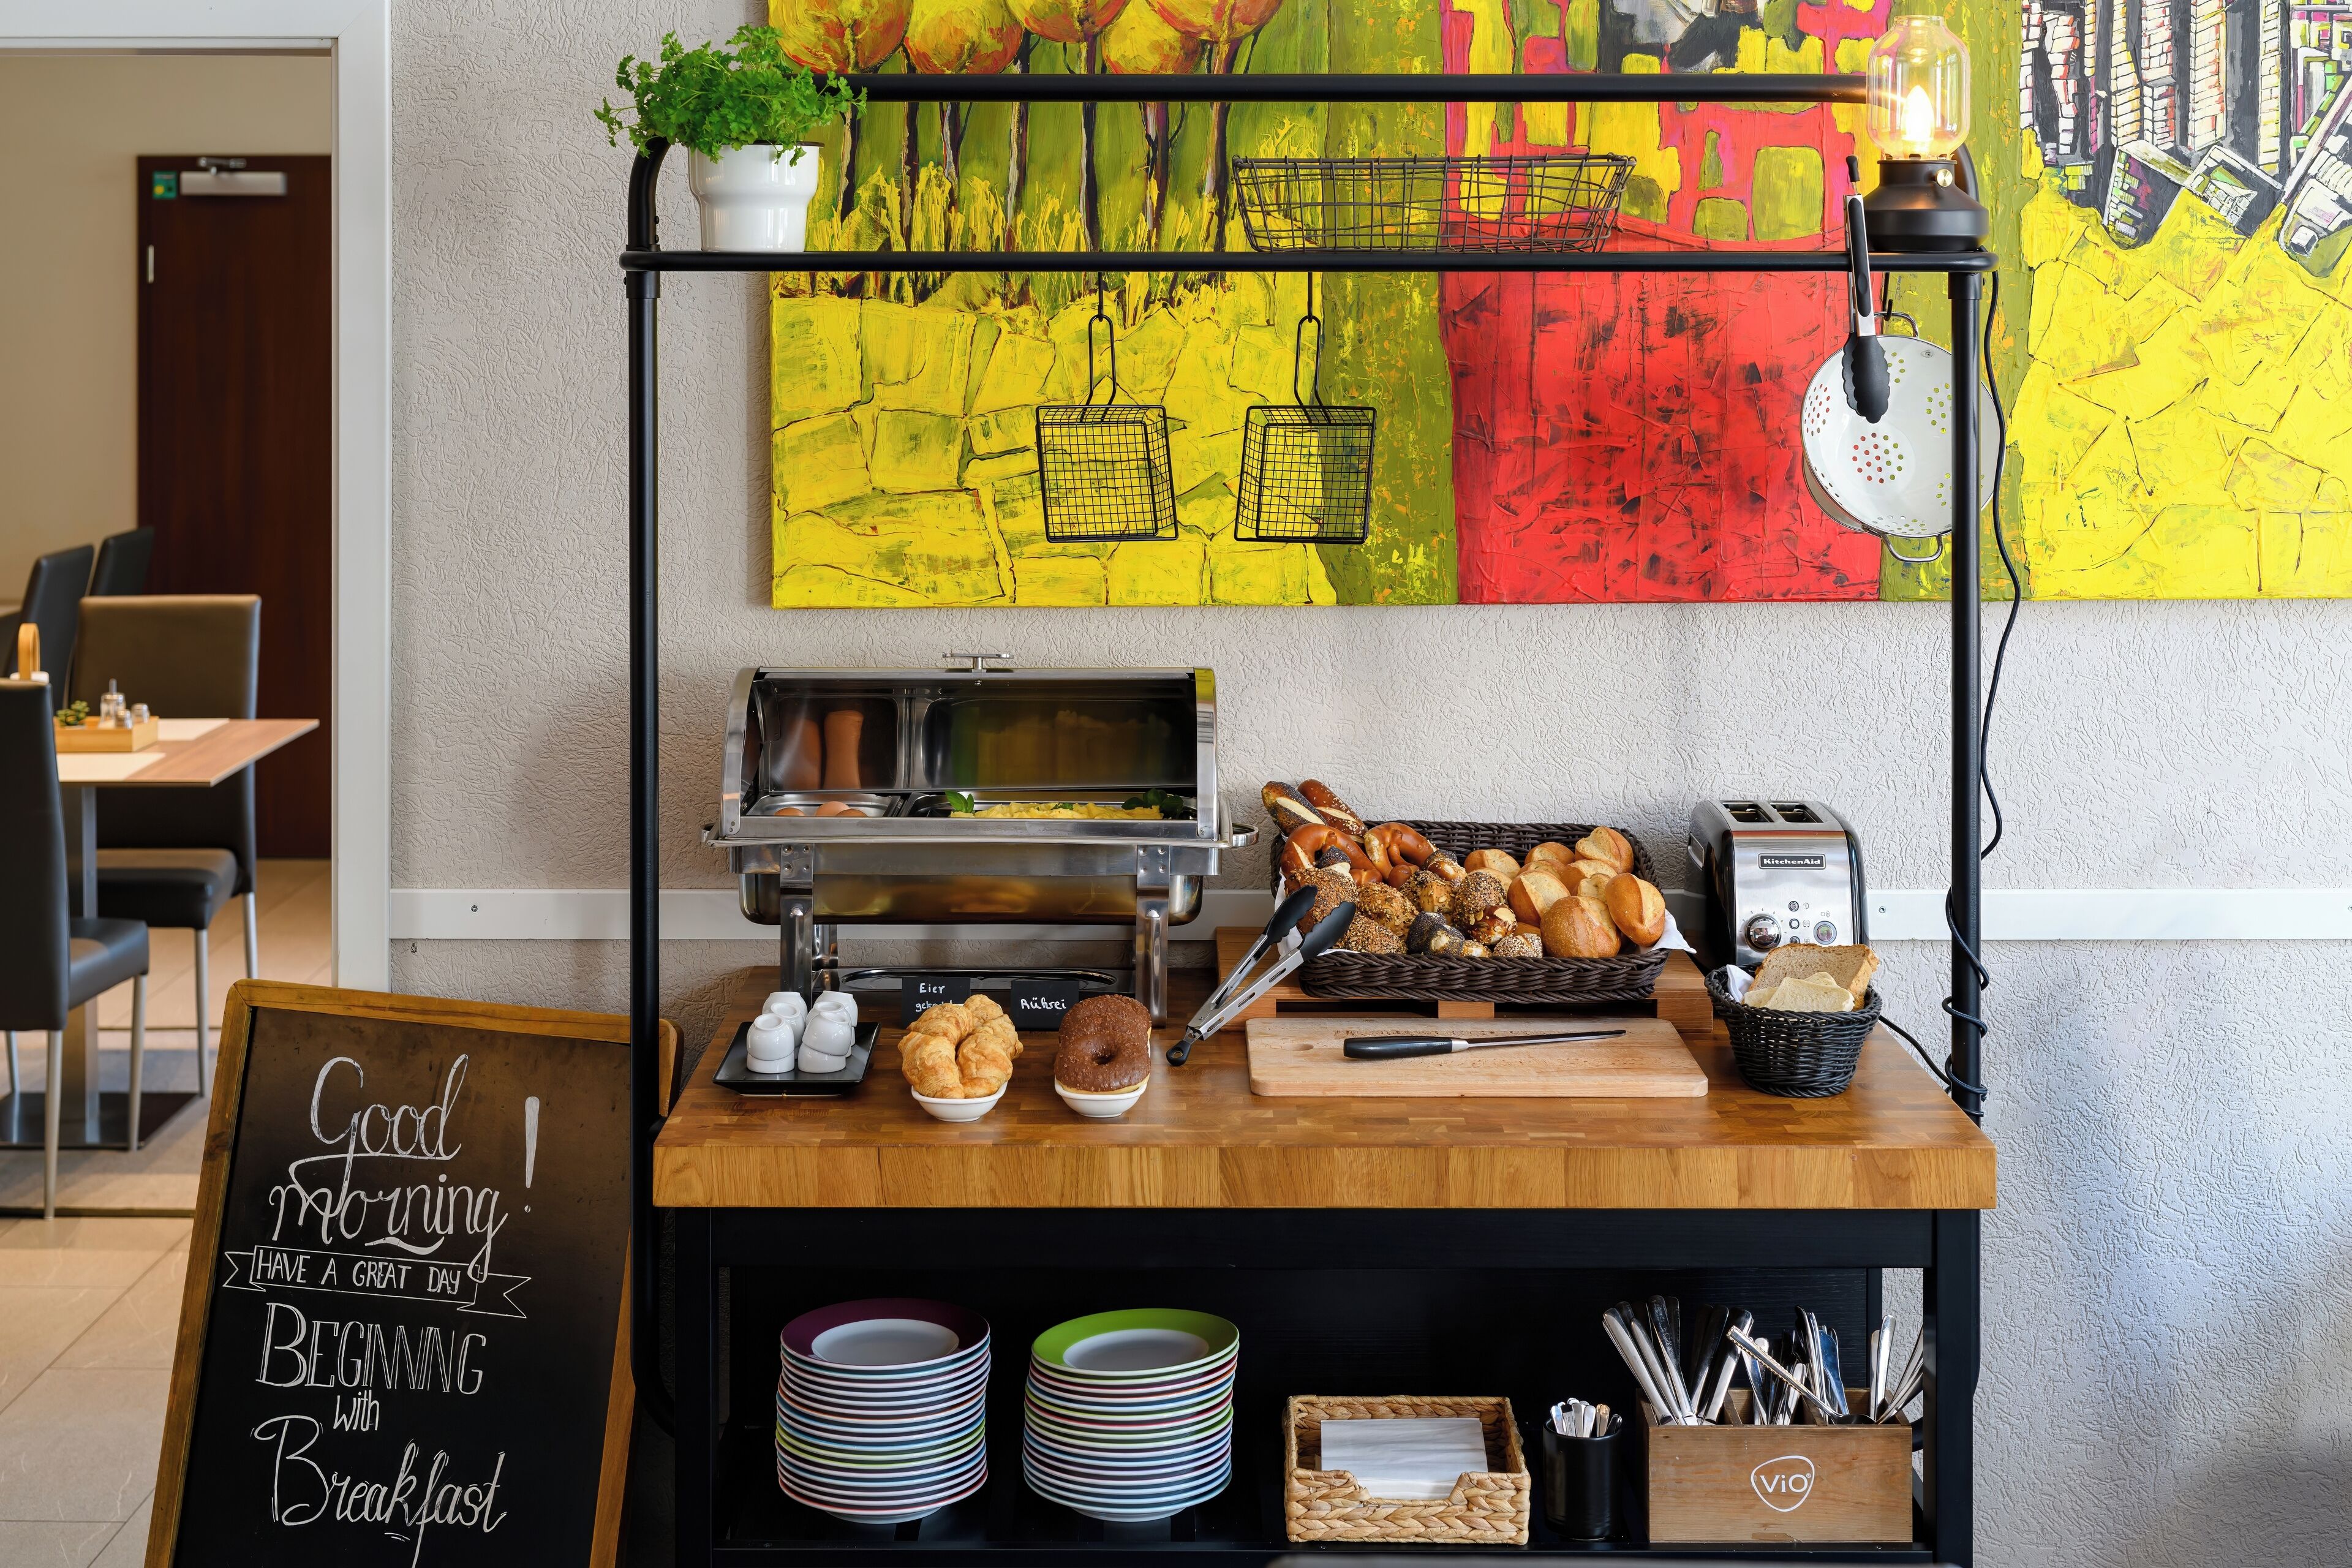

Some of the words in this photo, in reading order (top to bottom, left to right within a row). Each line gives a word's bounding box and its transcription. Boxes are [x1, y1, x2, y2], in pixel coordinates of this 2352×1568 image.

[919, 982, 946, 994] Eier
[288, 1054, 469, 1218] Good
[255, 1249, 311, 1284] HAVE
[320, 1257, 337, 1286] A
[352, 1261, 412, 1290] GREAT
[427, 1266, 462, 1295] DAY
[255, 1302, 486, 1395] BEGINNING
[333, 1390, 380, 1431] with
[251, 1415, 508, 1568] Breakfast
